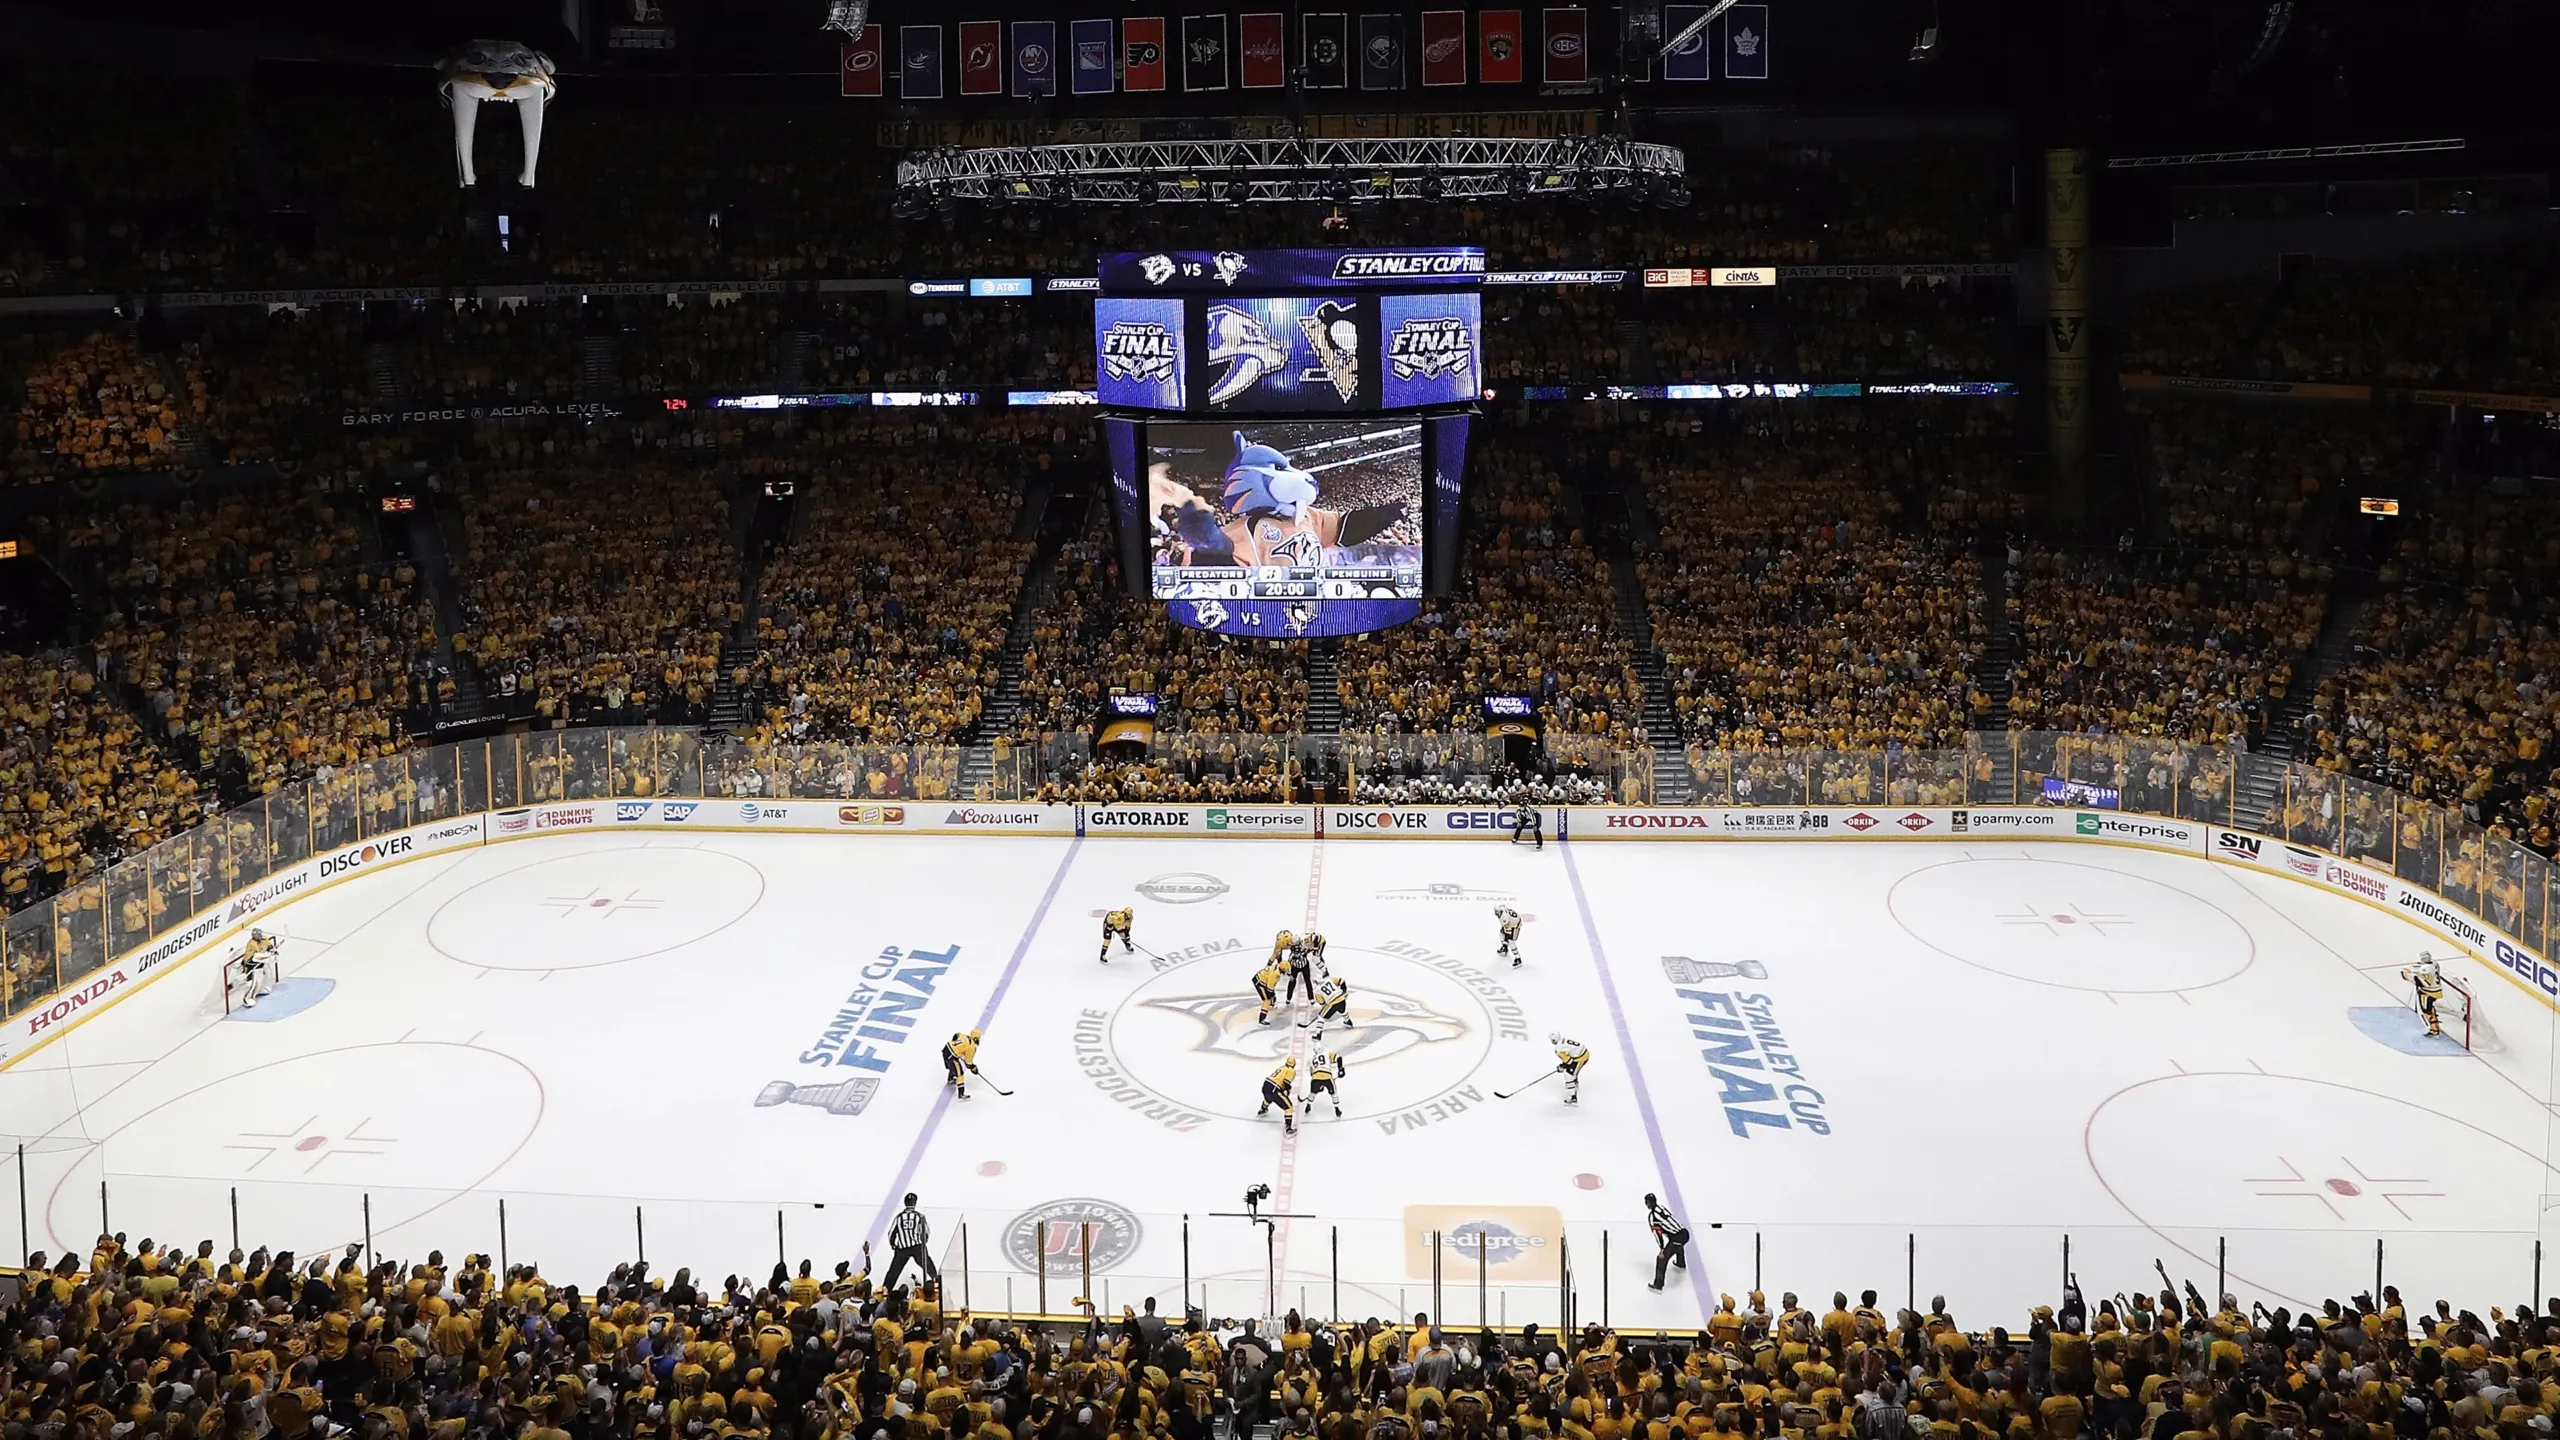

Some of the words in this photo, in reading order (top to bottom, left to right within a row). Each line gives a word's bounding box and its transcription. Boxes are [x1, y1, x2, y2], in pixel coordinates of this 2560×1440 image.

[1415, 116, 1441, 137] BE
[1447, 115, 1489, 137] THE
[1498, 114, 1529, 136] 7TH
[1536, 113, 1585, 136] MAN
[911, 123, 950, 146] THE
[1182, 264, 1202, 277] VS
[1341, 257, 1432, 274] STANLEY
[1433, 256, 1463, 272] CUP
[1826, 266, 1881, 276] FORCE
[1903, 265, 1956, 275] ACURA
[1963, 265, 2013, 275] LEVEL
[1051, 279, 1095, 288] STANLEY
[1485, 273, 1532, 282] STANLEY
[1554, 272, 1591, 282] FINAL
[677, 283, 732, 293] ACURA
[996, 282, 1021, 292] AT&T
[1114, 325, 1147, 335] STANLEY
[1147, 325, 1165, 335] CUP
[1405, 322, 1441, 333] STANLEY
[1442, 320, 1460, 331] CUP
[1105, 334, 1176, 356] FINAL
[1391, 329, 1471, 353] FINAL
[342, 412, 394, 427] GARY
[402, 409, 466, 422] FORCE
[489, 405, 550, 418] ACURA
[556, 402, 612, 415] LEVEL
[1181, 570, 1244, 579] PREDATORS
[1332, 570, 1387, 578] PENGUINS
[1229, 583, 1238, 597] 0
[1265, 582, 1306, 596] 20:00
[1335, 583, 1343, 597] 0
[1241, 612, 1261, 626] VS
[446, 717, 478, 727] LEXUS
[478, 713, 506, 723] LOUNGE
[552, 807, 595, 819] DUNKIN'
[617, 805, 645, 819] SAP
[664, 805, 692, 819] SAP
[762, 808, 789, 819] AT&T
[962, 808, 1002, 825] Coors
[1003, 813, 1040, 825] LIGHT
[1091, 811, 1189, 826] GATORADE
[552, 816, 593, 826] DONUTS
[1213, 813, 1305, 828] enterprise
[1336, 812, 1428, 829] DISCOVER
[1606, 815, 1709, 828] HONDA
[1812, 815, 1829, 828] 88
[1848, 818, 1875, 826] ORKIN
[1901, 818, 1928, 826] ORKIN
[1973, 813, 2054, 827] goarmy.com
[439, 824, 478, 839] NBCSN
[2083, 819, 2189, 841] enterprise
[2218, 832, 2262, 855] SN
[320, 834, 413, 878] DISCOVER
[2343, 869, 2389, 892] DUNKIN'
[240, 889, 276, 914] Coors
[275, 872, 309, 896] LIGHT
[1146, 884, 1221, 894] NISSAN
[2343, 880, 2387, 901] DONUTS
[2399, 890, 2488, 948] BRIDGESTONE
[138, 914, 221, 974] BRIDGESTONE
[1150, 937, 1243, 972] ARENA
[1320, 981, 1336, 996] 87
[1375, 939, 1530, 1043] BRIDGESTONE
[29, 970, 129, 1036] HONDA
[799, 982, 879, 1068] STANLEY
[861, 945, 904, 981] CUP
[835, 943, 962, 1073] FINAL
[1312, 1054, 1327, 1069] 59
[1674, 987, 1793, 1140] FINAL
[1734, 991, 1806, 1082] STANLEY
[1783, 1084, 1832, 1136] CUP
[1073, 1008, 1212, 1132] BRIDGESTONE
[843, 1081, 873, 1112] 2017
[1376, 1084, 1485, 1136] ARENA
[903, 1220, 913, 1229] 50
[1018, 1204, 1077, 1237] JIMMY
[1081, 1204, 1130, 1238] JOHN'S
